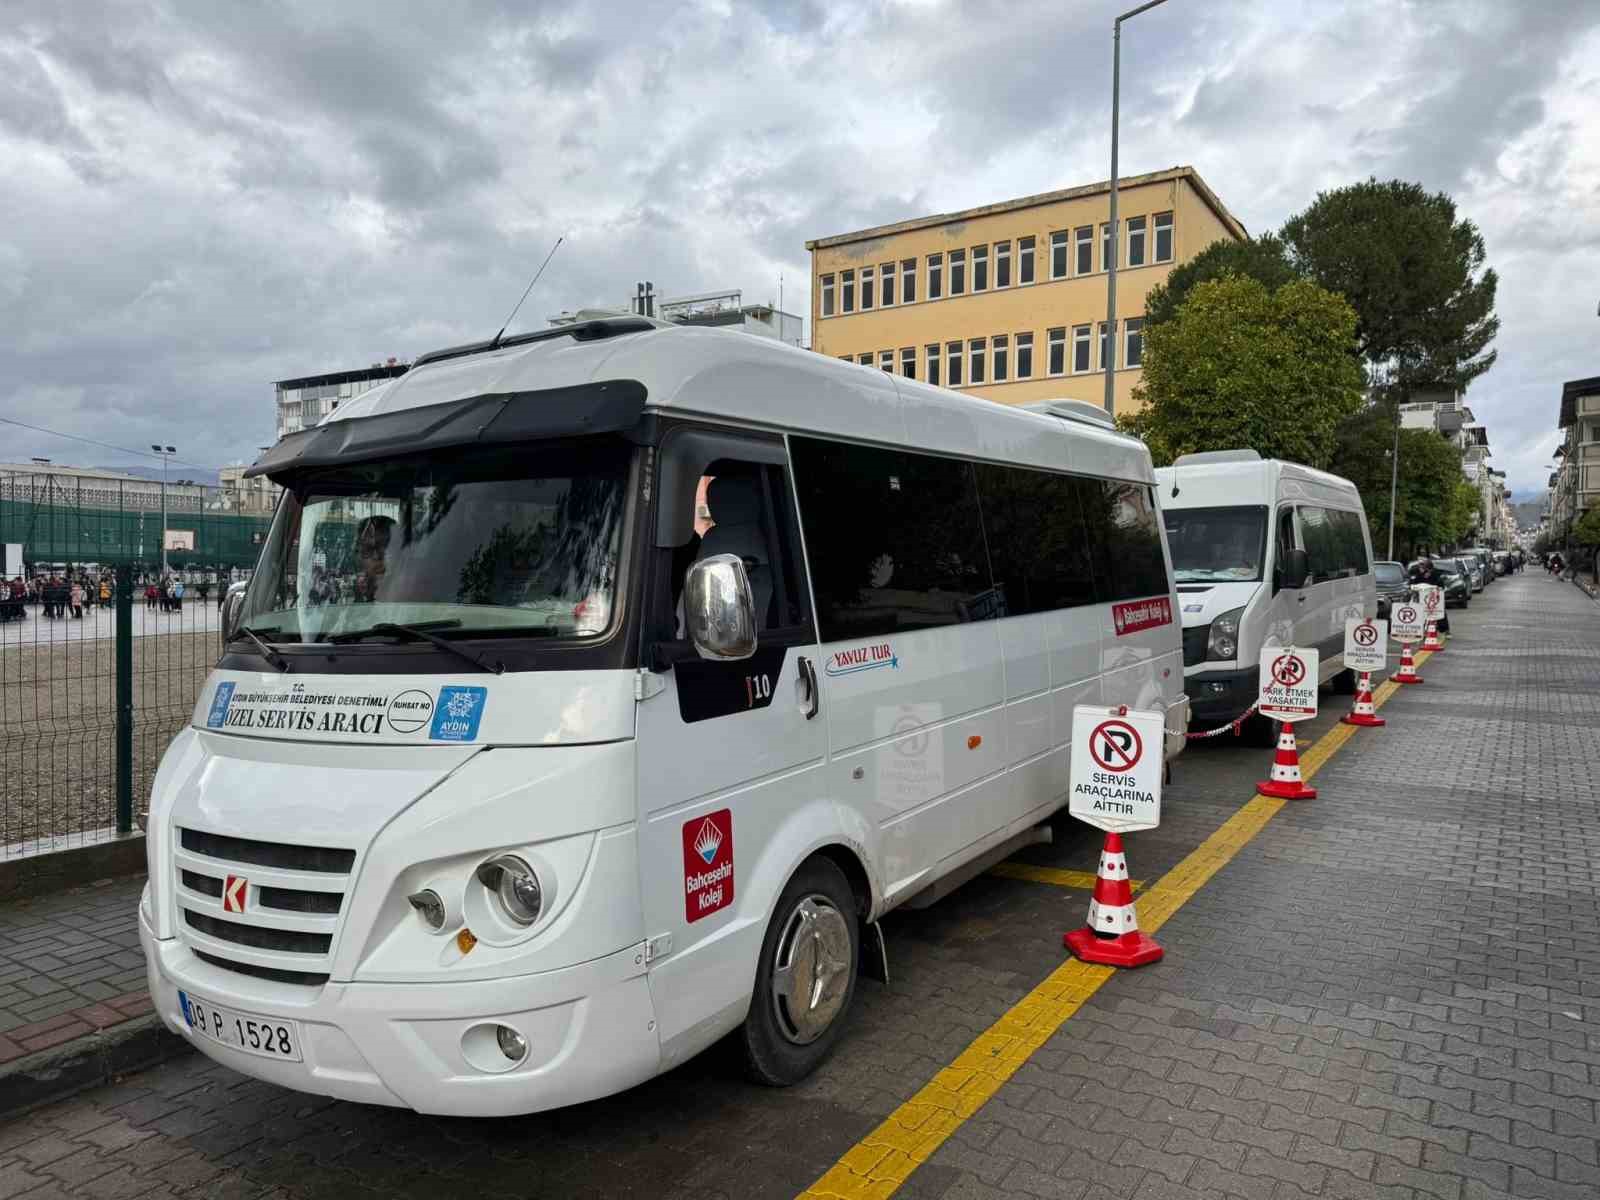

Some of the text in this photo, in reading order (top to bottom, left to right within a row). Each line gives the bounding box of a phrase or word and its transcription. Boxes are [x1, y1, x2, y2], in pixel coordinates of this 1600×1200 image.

[834, 644, 891, 667] YAVUZ TUR
[393, 701, 430, 710] RUHSAT NO
[225, 704, 254, 728] ÖZEL
[257, 706, 316, 730] SERVİS
[317, 711, 385, 734] ARACI
[440, 721, 470, 732] AYDIN
[1092, 772, 1136, 788] SERVİS
[1074, 783, 1155, 803] ARAÇLARINA
[1093, 799, 1134, 815] AİTTİR
[686, 860, 732, 894] Bahçeşehir
[699, 884, 723, 911] Koleji
[188, 1000, 292, 1055] 09 P 1528
